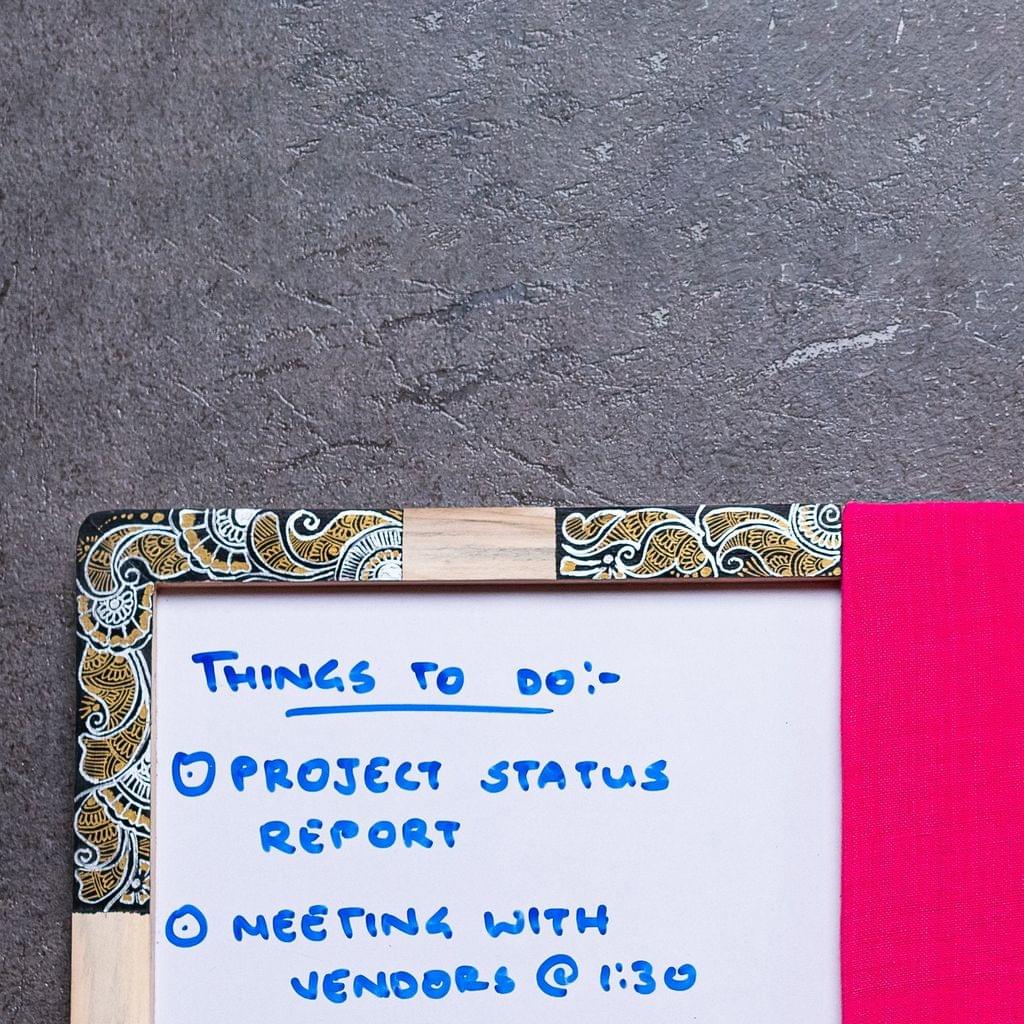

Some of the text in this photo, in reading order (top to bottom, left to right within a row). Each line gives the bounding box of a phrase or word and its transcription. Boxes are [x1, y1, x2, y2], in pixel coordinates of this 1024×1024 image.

[192, 650, 376, 694] THINGS
[410, 661, 464, 695] TO
[230, 755, 670, 796] PROJECT STATUS
[259, 818, 461, 855] REPORT
[233, 904, 608, 943] MEETING WITH
[290, 954, 697, 1004] VENDORS @ 1:30
